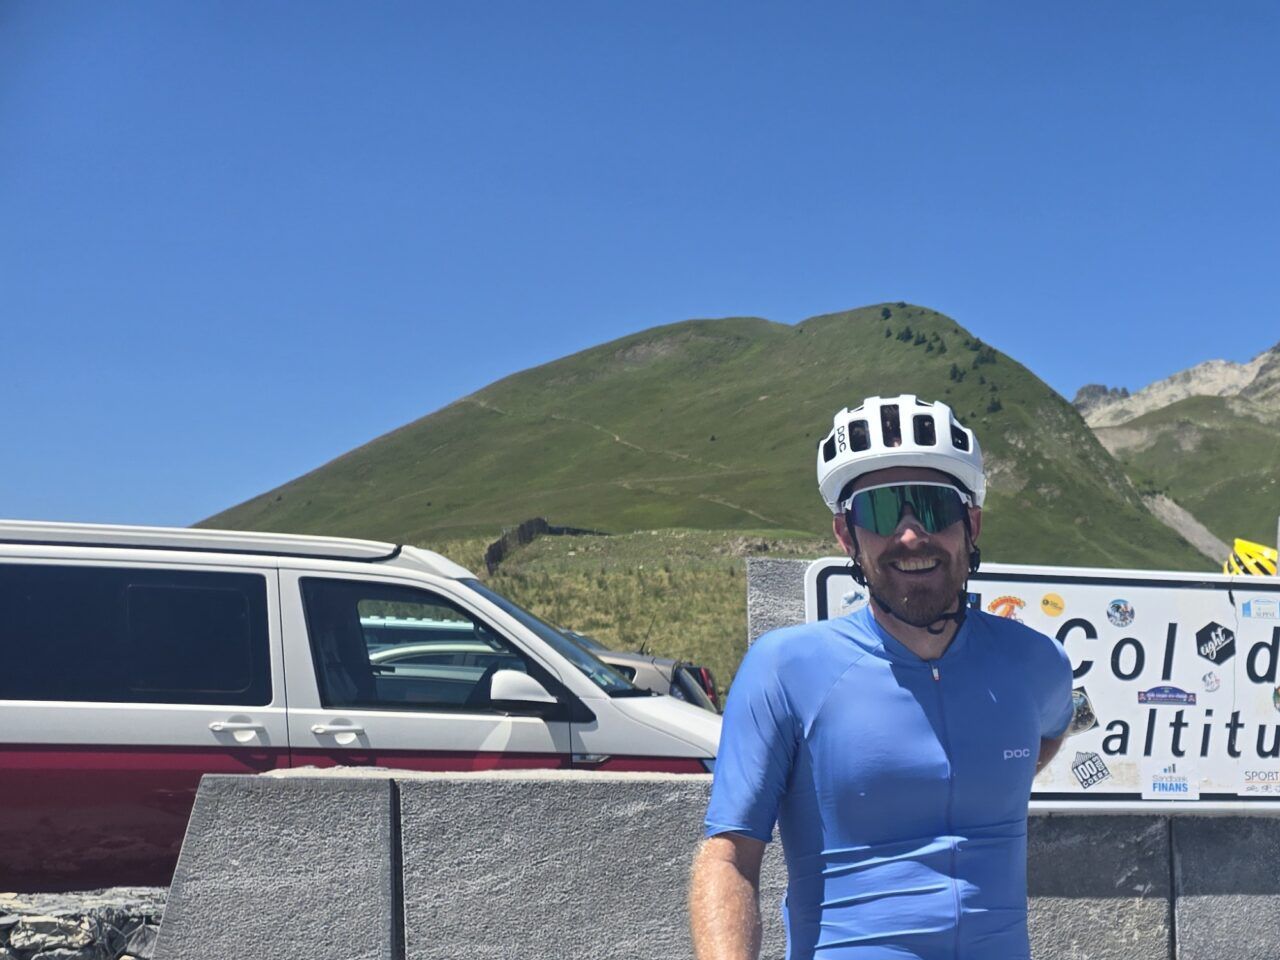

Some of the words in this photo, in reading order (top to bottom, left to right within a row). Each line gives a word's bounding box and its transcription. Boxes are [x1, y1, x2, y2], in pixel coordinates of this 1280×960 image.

[1056, 617, 1178, 681] Col
[1073, 760, 1099, 783] 100
[1244, 770, 1280, 781] SPORT
[1152, 782, 1189, 792] FINANS
